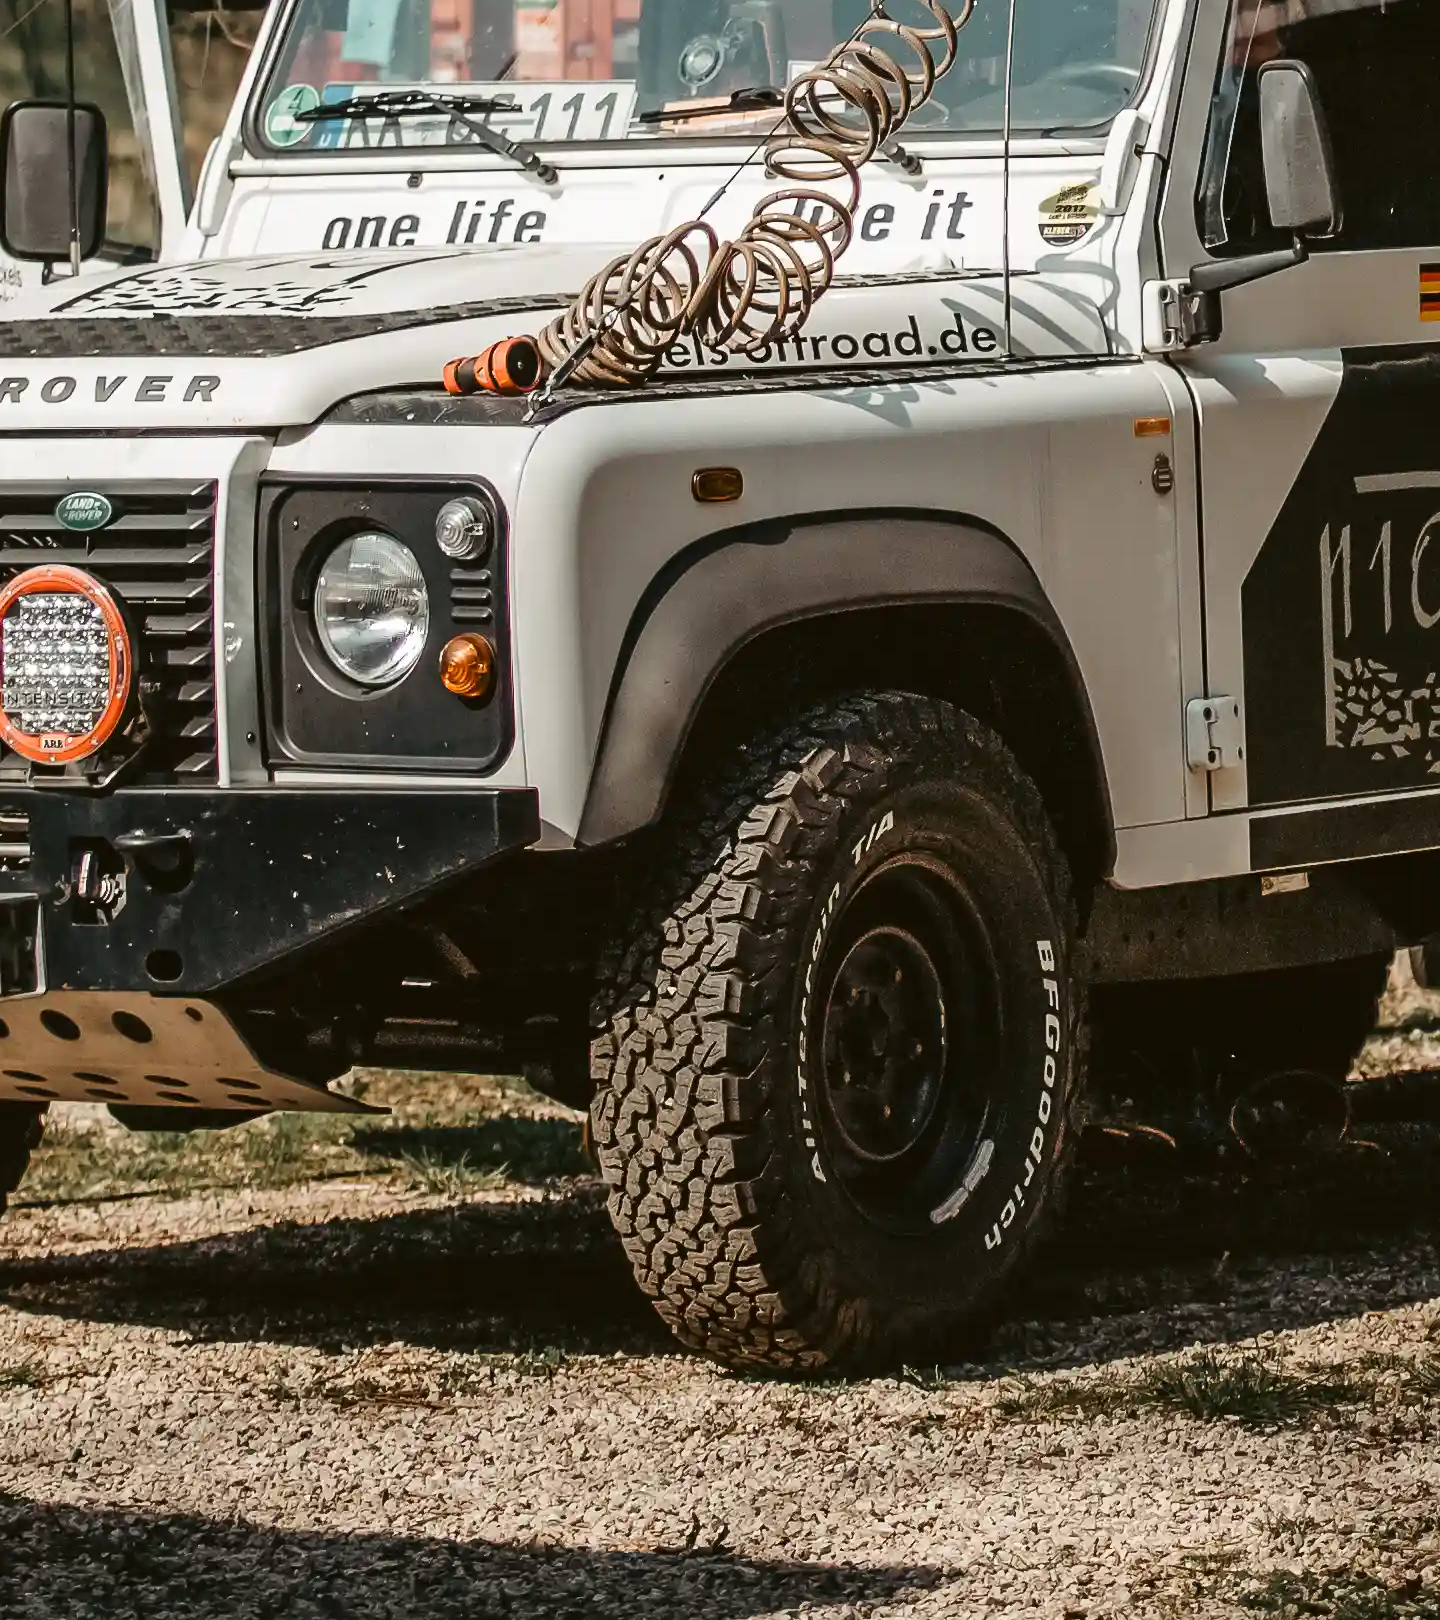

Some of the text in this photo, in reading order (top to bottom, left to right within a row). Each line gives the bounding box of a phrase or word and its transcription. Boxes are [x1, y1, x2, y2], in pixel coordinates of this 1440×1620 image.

[529, 91, 619, 141] 111
[321, 213, 421, 251] one
[445, 198, 548, 244] life
[920, 189, 974, 242] it
[660, 313, 998, 370] els-offroad.de
[65, 497, 96, 510] LAND
[67, 509, 103, 521] ROVER
[797, 810, 895, 1182] All-Terrain T/A
[983, 939, 1061, 1251] BFGoodrich
